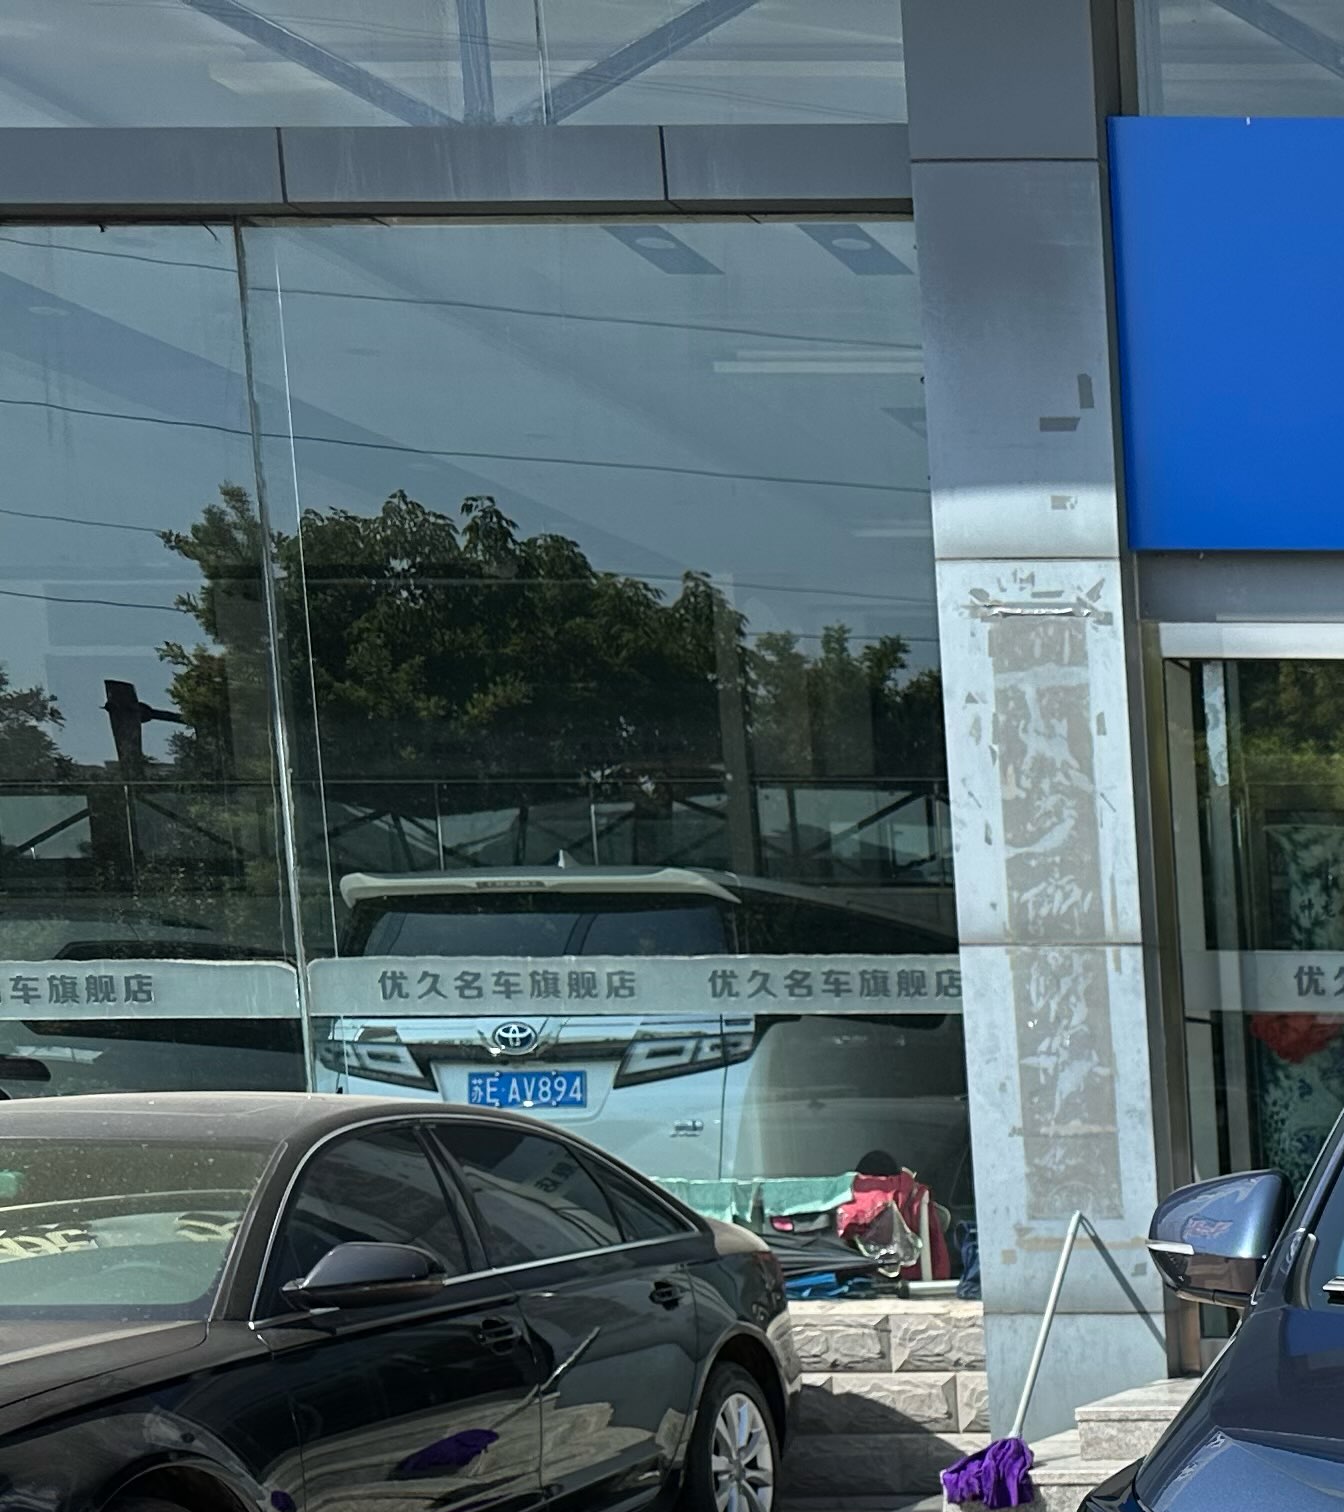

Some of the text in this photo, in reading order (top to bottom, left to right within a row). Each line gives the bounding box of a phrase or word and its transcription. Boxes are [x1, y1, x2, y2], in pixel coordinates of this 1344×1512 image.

[9, 974, 153, 1004] 车旗舰店
[378, 970, 637, 1000] 优久名车旗舰店
[708, 969, 962, 998] 优久名车旗舰店
